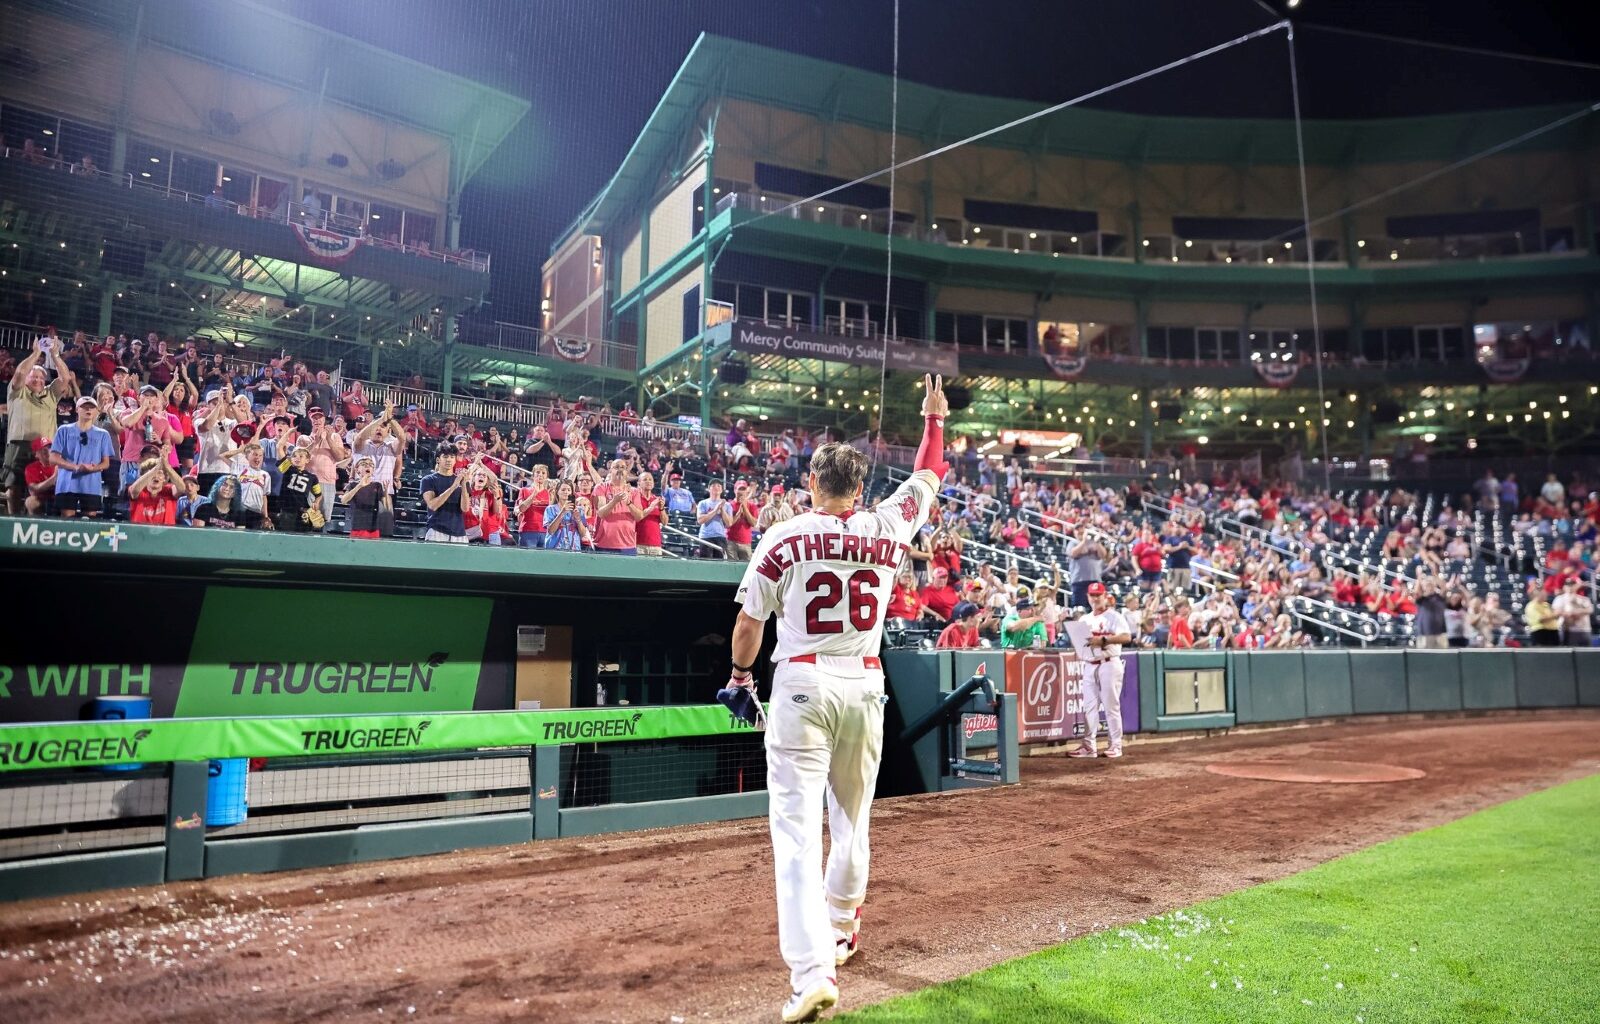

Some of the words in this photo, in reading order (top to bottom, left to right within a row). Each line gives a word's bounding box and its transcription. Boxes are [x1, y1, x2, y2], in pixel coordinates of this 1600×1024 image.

[740, 330, 780, 349] Mercy
[783, 336, 854, 359] Community
[286, 473, 310, 493] 15
[12, 522, 99, 552] Mercy
[805, 569, 880, 634] 26
[27, 663, 151, 697] WITH
[228, 661, 434, 695] TRUGREEN
[1037, 705, 1051, 717] LIVE
[301, 727, 422, 751] TRUGREEN
[542, 719, 637, 740] TRUGREEN
[0, 737, 139, 764] RUGREEN
